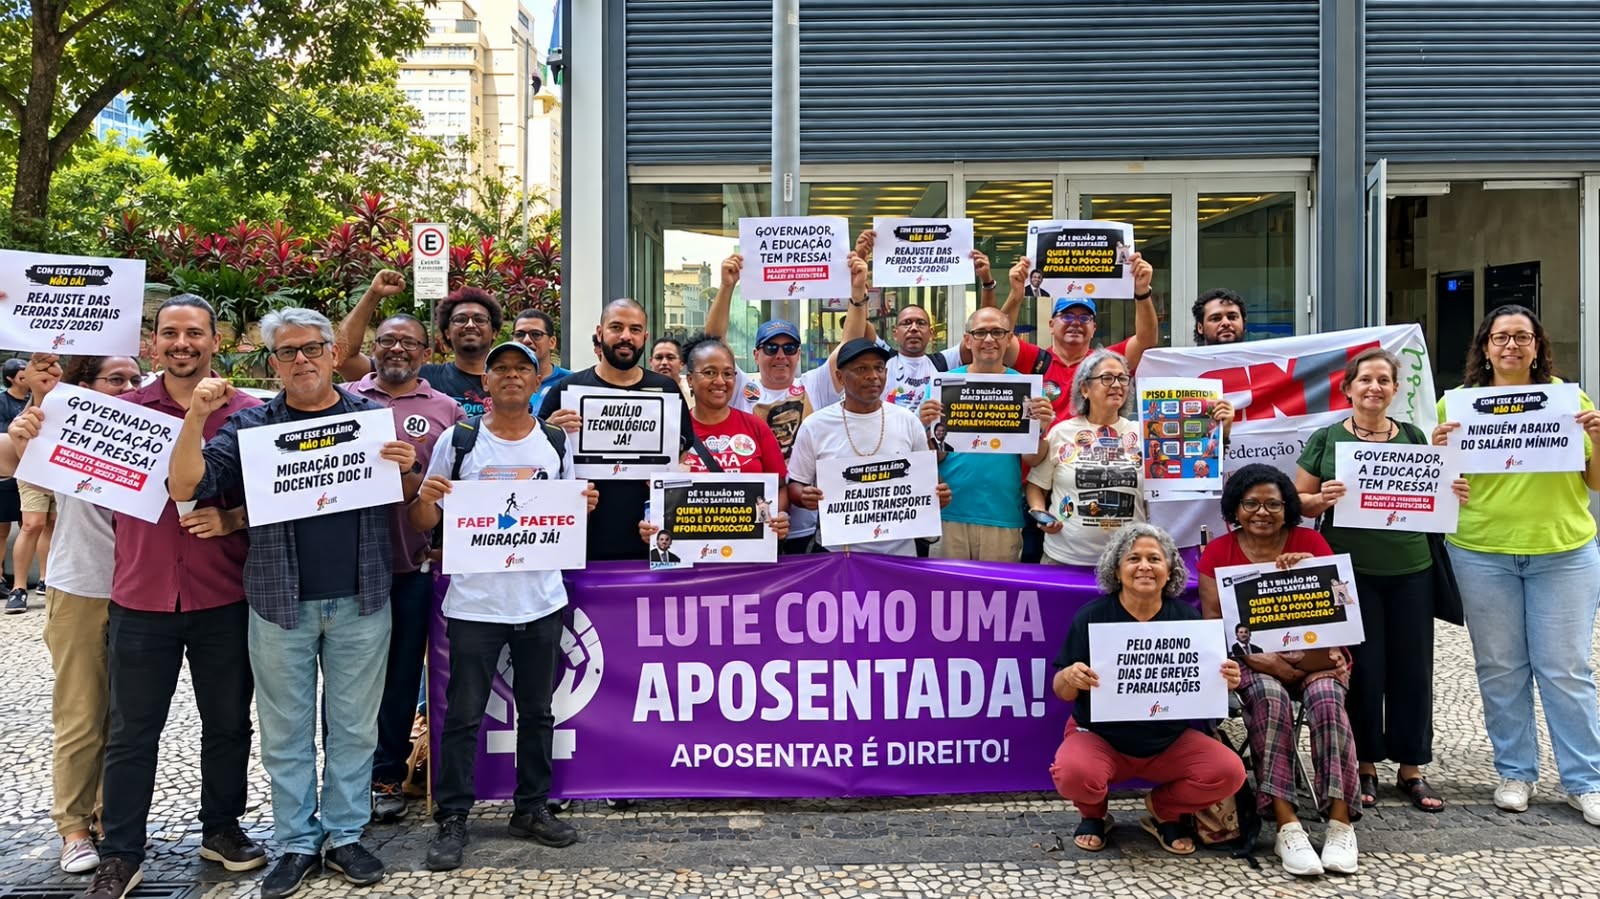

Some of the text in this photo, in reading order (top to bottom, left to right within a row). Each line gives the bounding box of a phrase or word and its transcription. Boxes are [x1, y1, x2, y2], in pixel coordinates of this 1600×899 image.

[756, 226, 835, 238] GOVERNADOR,
[425, 235, 437, 251] E
[760, 237, 832, 251] A EDUCAÇÃO
[760, 252, 831, 263] TEM PRESSA!
[895, 247, 952, 255] REAJUSTE DAS
[899, 265, 949, 273] (2025/2026)
[27, 292, 111, 306] REAJUSTE DAS
[13, 305, 120, 319] PERDAS SALARIAIS
[30, 319, 104, 331] (2025/2026)
[1146, 390, 1166, 399] PISO
[601, 403, 642, 417] AUXÍLIO
[68, 396, 172, 442] GOVERNADOR,
[406, 417, 426, 433] 80
[587, 417, 656, 432] TECNOLÓGICO
[66, 414, 163, 454] A EDUCAÇÃO
[1468, 422, 1560, 435] NINGUÉM ABAIXO
[285, 432, 302, 442] COM
[304, 430, 320, 440] ESSE
[613, 433, 632, 446] JÁ!
[1461, 436, 1569, 450] DO SALÁRIO MÍNIMO
[60, 428, 92, 449] TEM
[93, 441, 157, 471] PRESSA!
[277, 452, 365, 477] MIGRAÇÃO DOS
[1354, 451, 1444, 466] GOVERNADOR,
[1359, 465, 1440, 481] A EDUCAÇÃO
[274, 467, 372, 494] DOCENTES DOC II
[1358, 479, 1438, 493] TEM PRESSA!
[845, 485, 912, 500] REAJUSTE DOS
[872, 495, 931, 510] TRANSPORTE
[676, 507, 702, 516] QUEM
[704, 507, 718, 515] VAI
[845, 508, 917, 525] E ALIMENTAÇÃO
[457, 516, 575, 528] FAEP FAETEC
[471, 529, 560, 548] MIGRAÇÃO JÁ!
[1276, 595, 1291, 603] VAI
[1281, 604, 1287, 612] O
[1289, 602, 1313, 610] POVO
[637, 589, 1046, 647] LUTE COMO UMA
[1127, 638, 1190, 651] PELO ABONO
[1117, 652, 1198, 666] FUNCIONAL DOS
[1118, 667, 1200, 680] DIAS DE GREVES
[632, 658, 1047, 722] APOSENTADA!
[1117, 679, 1200, 696] E PARALISAÇÕES
[671, 737, 1010, 768] APOSENTAR É DIREITO!
